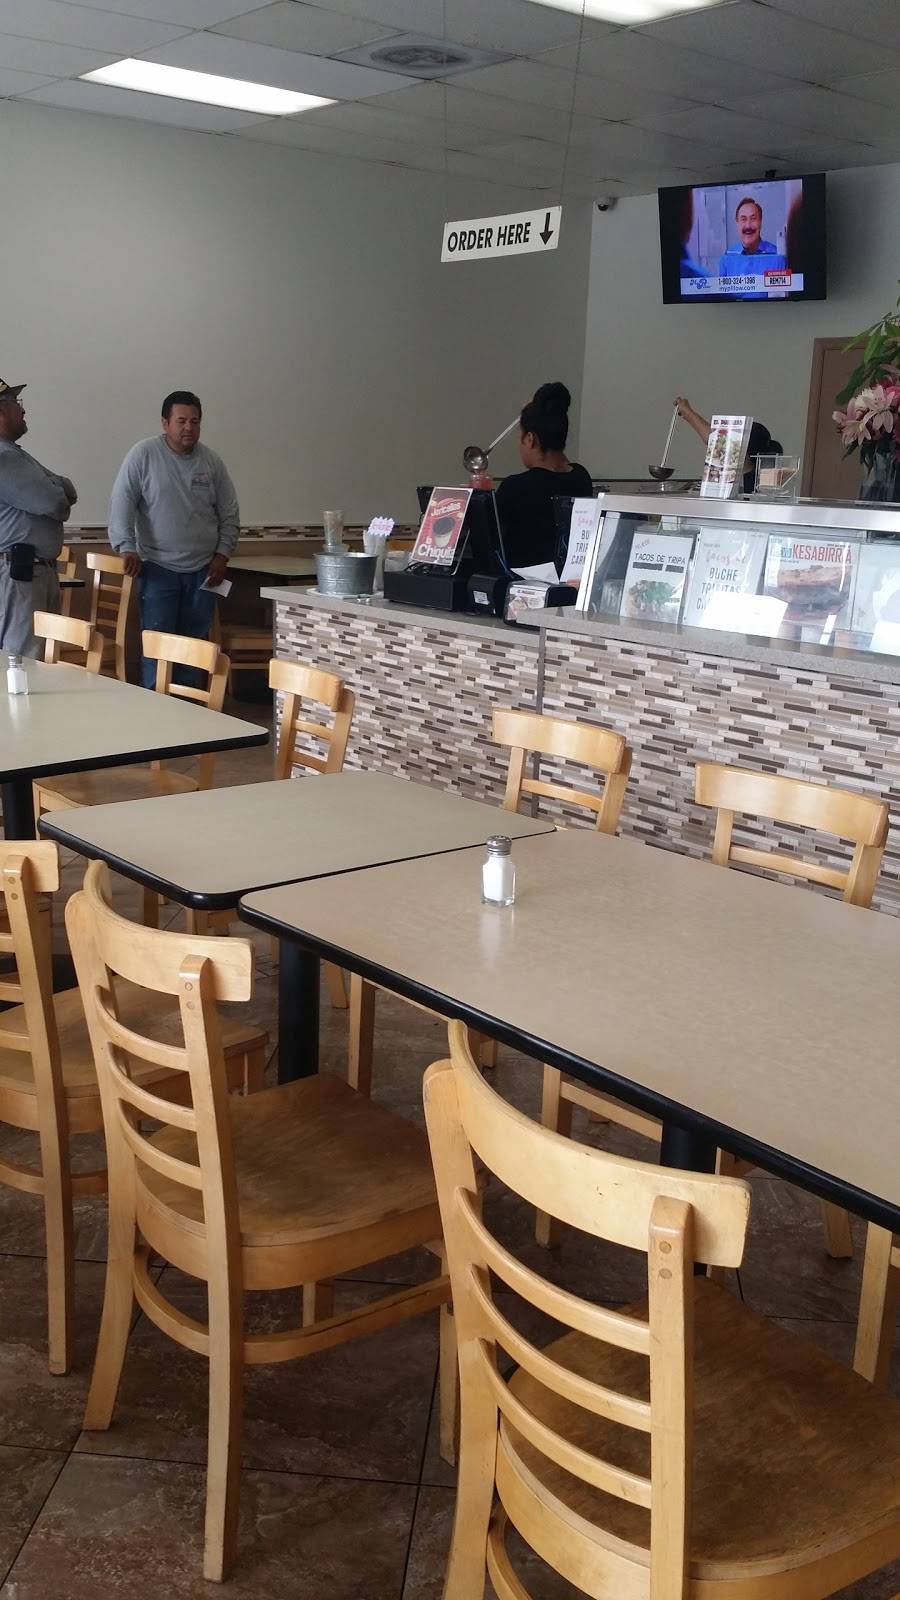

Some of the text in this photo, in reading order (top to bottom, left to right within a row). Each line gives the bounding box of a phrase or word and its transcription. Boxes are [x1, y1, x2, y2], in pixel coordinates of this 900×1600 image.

[447, 222, 531, 252] ORDER HERE
[634, 552, 686, 565] TACOS DE TRIPA
[709, 567, 739, 581] BUCHE
